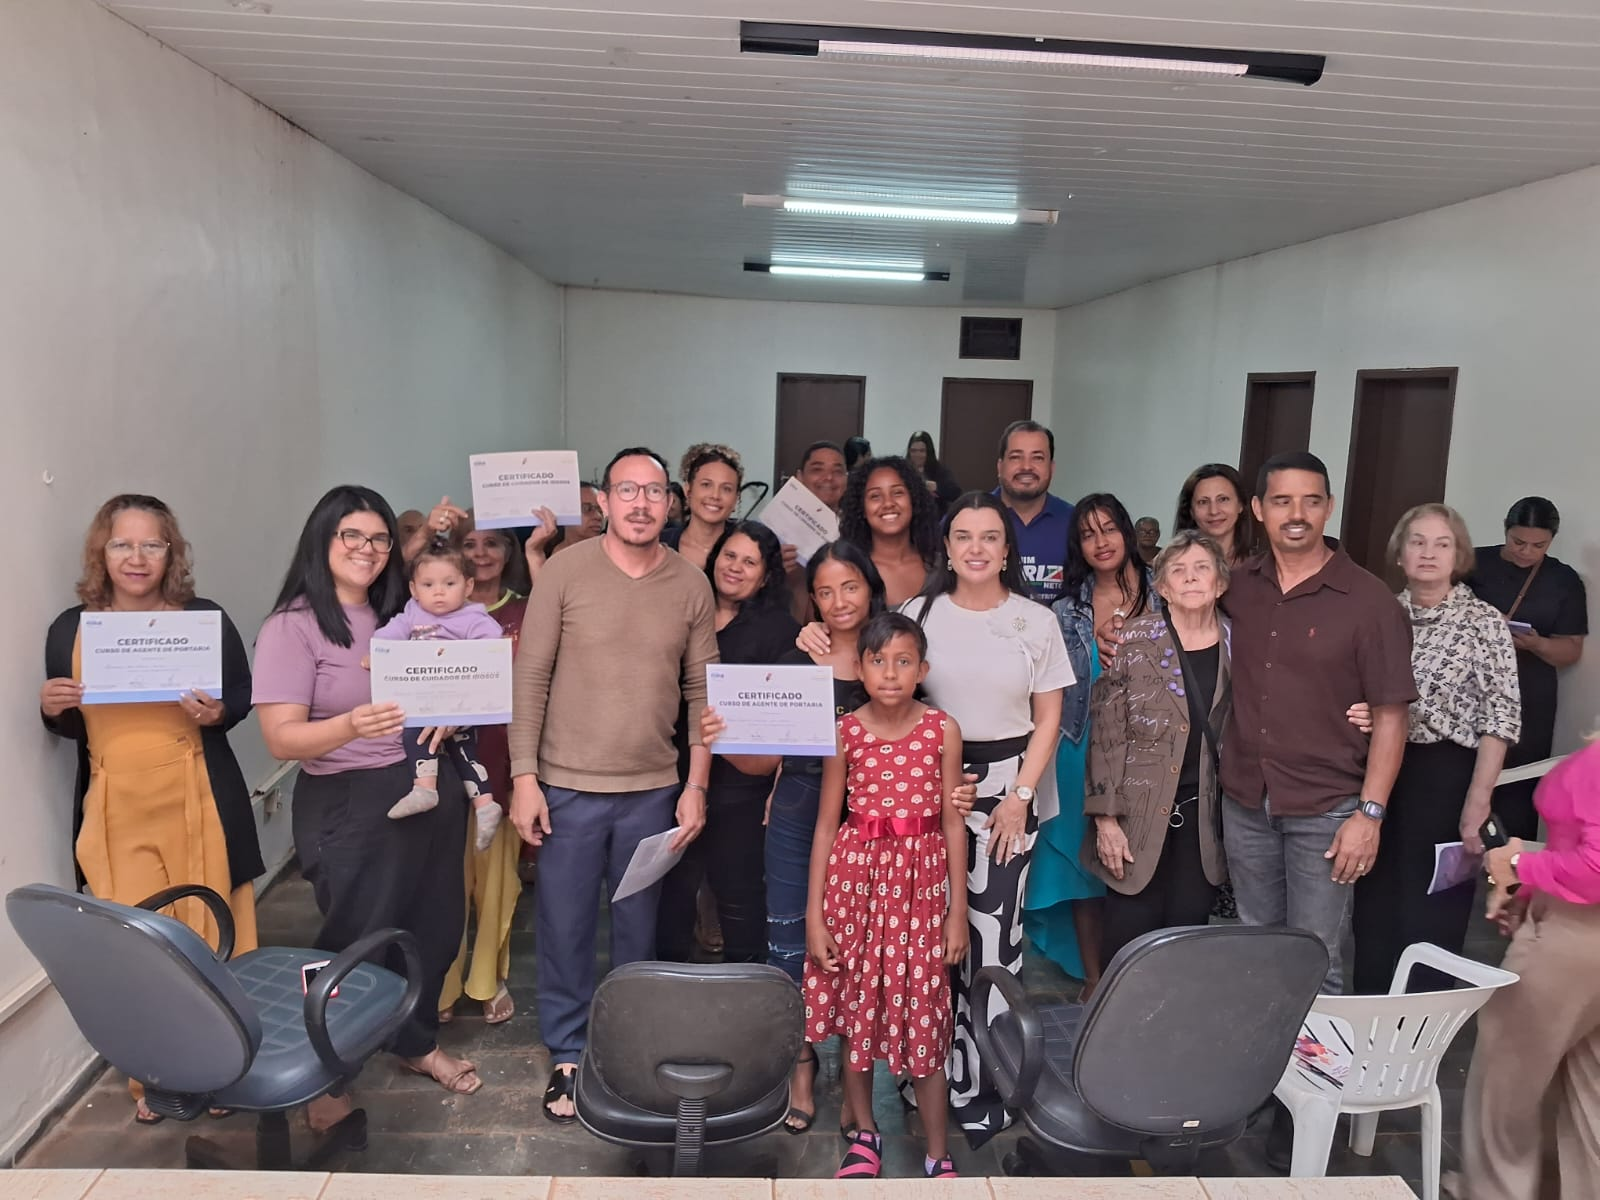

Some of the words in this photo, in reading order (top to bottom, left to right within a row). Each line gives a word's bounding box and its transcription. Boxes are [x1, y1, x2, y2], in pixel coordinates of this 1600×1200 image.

[498, 472, 554, 481] CERTIFICADO
[795, 505, 828, 535] CERTIFICADO
[117, 637, 189, 646] CERTIFICADO
[406, 666, 478, 675] CERTIFICADO
[738, 692, 802, 700] CERTIFICADO
